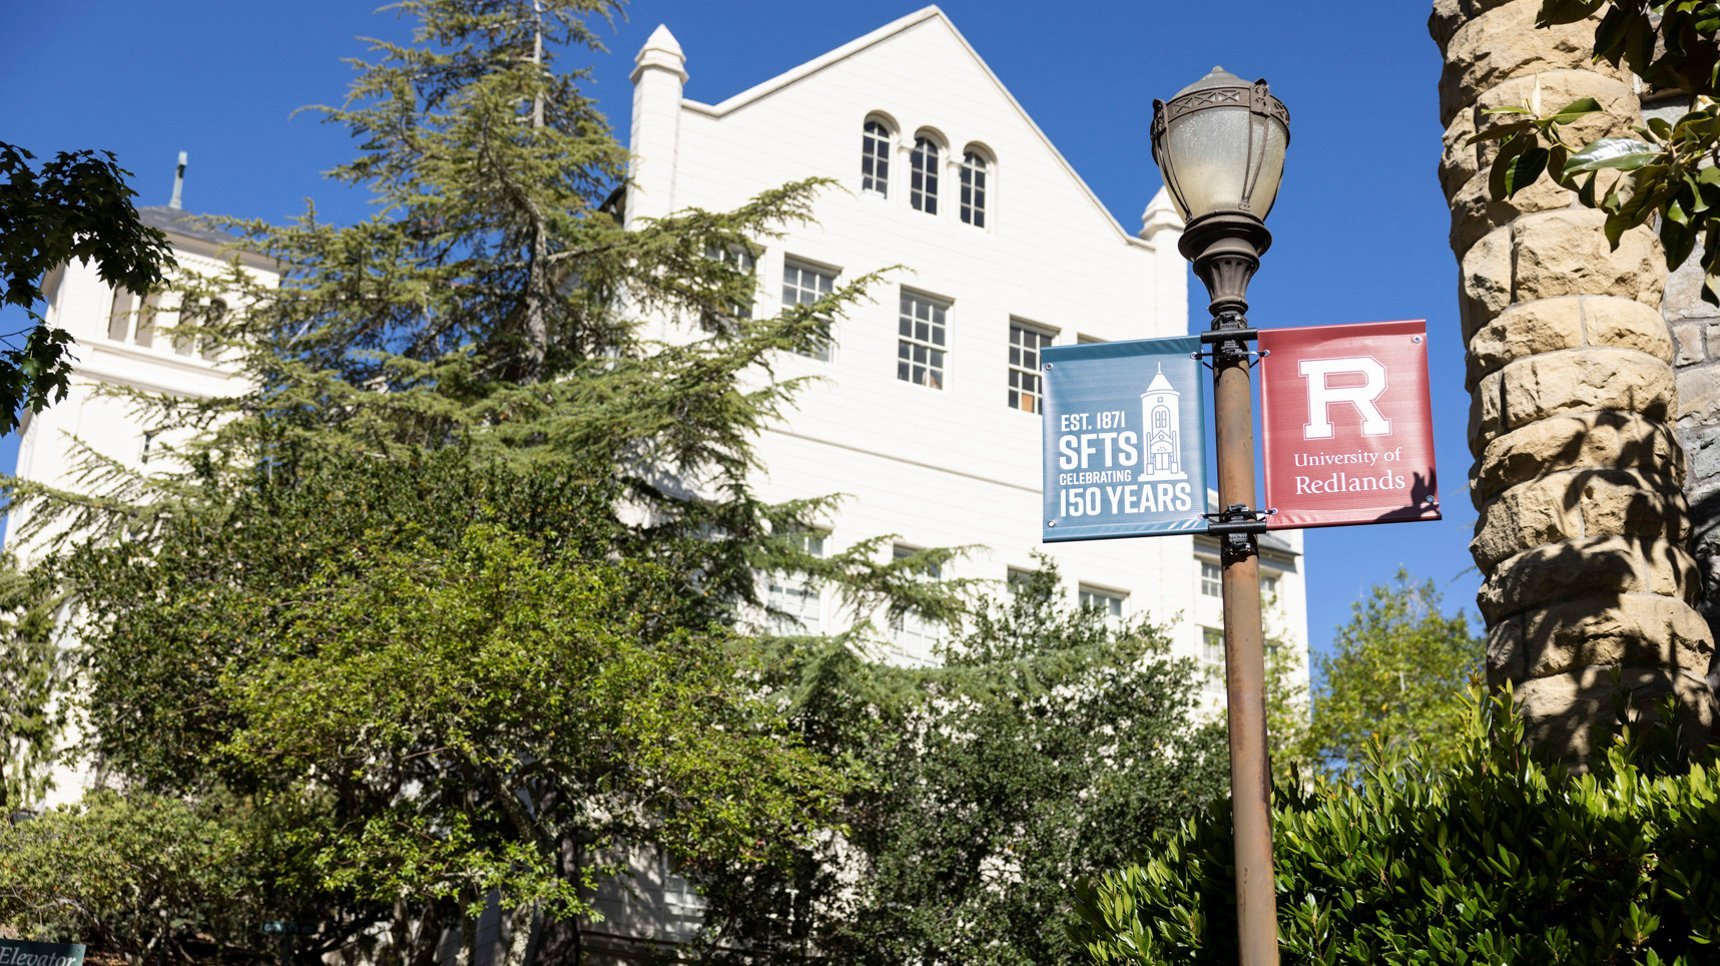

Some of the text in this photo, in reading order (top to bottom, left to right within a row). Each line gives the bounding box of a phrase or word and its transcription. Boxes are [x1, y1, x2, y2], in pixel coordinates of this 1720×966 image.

[1298, 355, 1392, 440] R
[1061, 410, 1125, 432] EST. 1871
[1059, 430, 1138, 470] SFTS
[1294, 447, 1403, 467] University of
[1059, 469, 1132, 486] CELEBRATING
[1295, 469, 1406, 495] Redlands
[1060, 482, 1192, 517] 150 YEARS
[0, 946, 76, 966] Elevator
